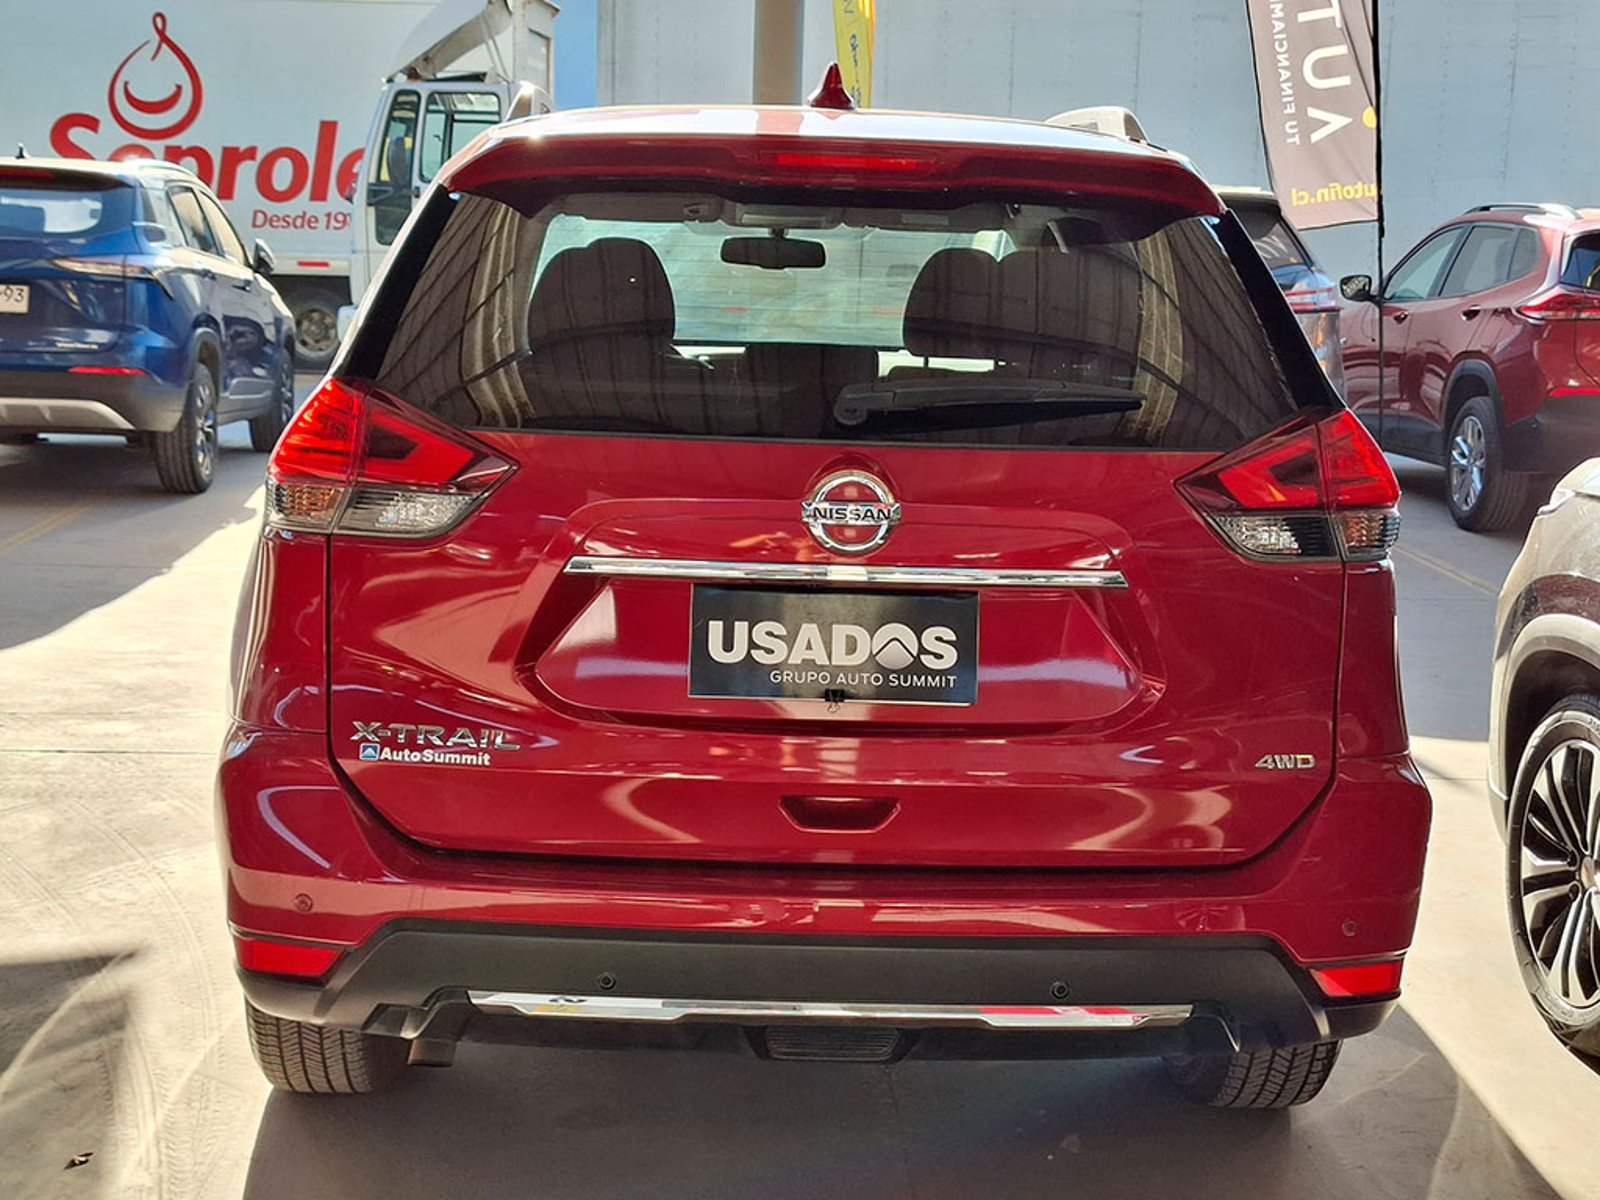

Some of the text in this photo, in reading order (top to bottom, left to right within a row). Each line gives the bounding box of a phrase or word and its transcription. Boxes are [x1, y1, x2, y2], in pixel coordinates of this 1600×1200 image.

[251, 209, 351, 231] Desde 19
[813, 506, 891, 521] NISSAN
[707, 620, 959, 670] USADOS
[769, 669, 957, 688] GRUPO AUTO SUMMIT
[350, 720, 521, 750] X-TRAIL
[380, 747, 491, 766] AutoSummit
[1254, 754, 1316, 770] 4WD
